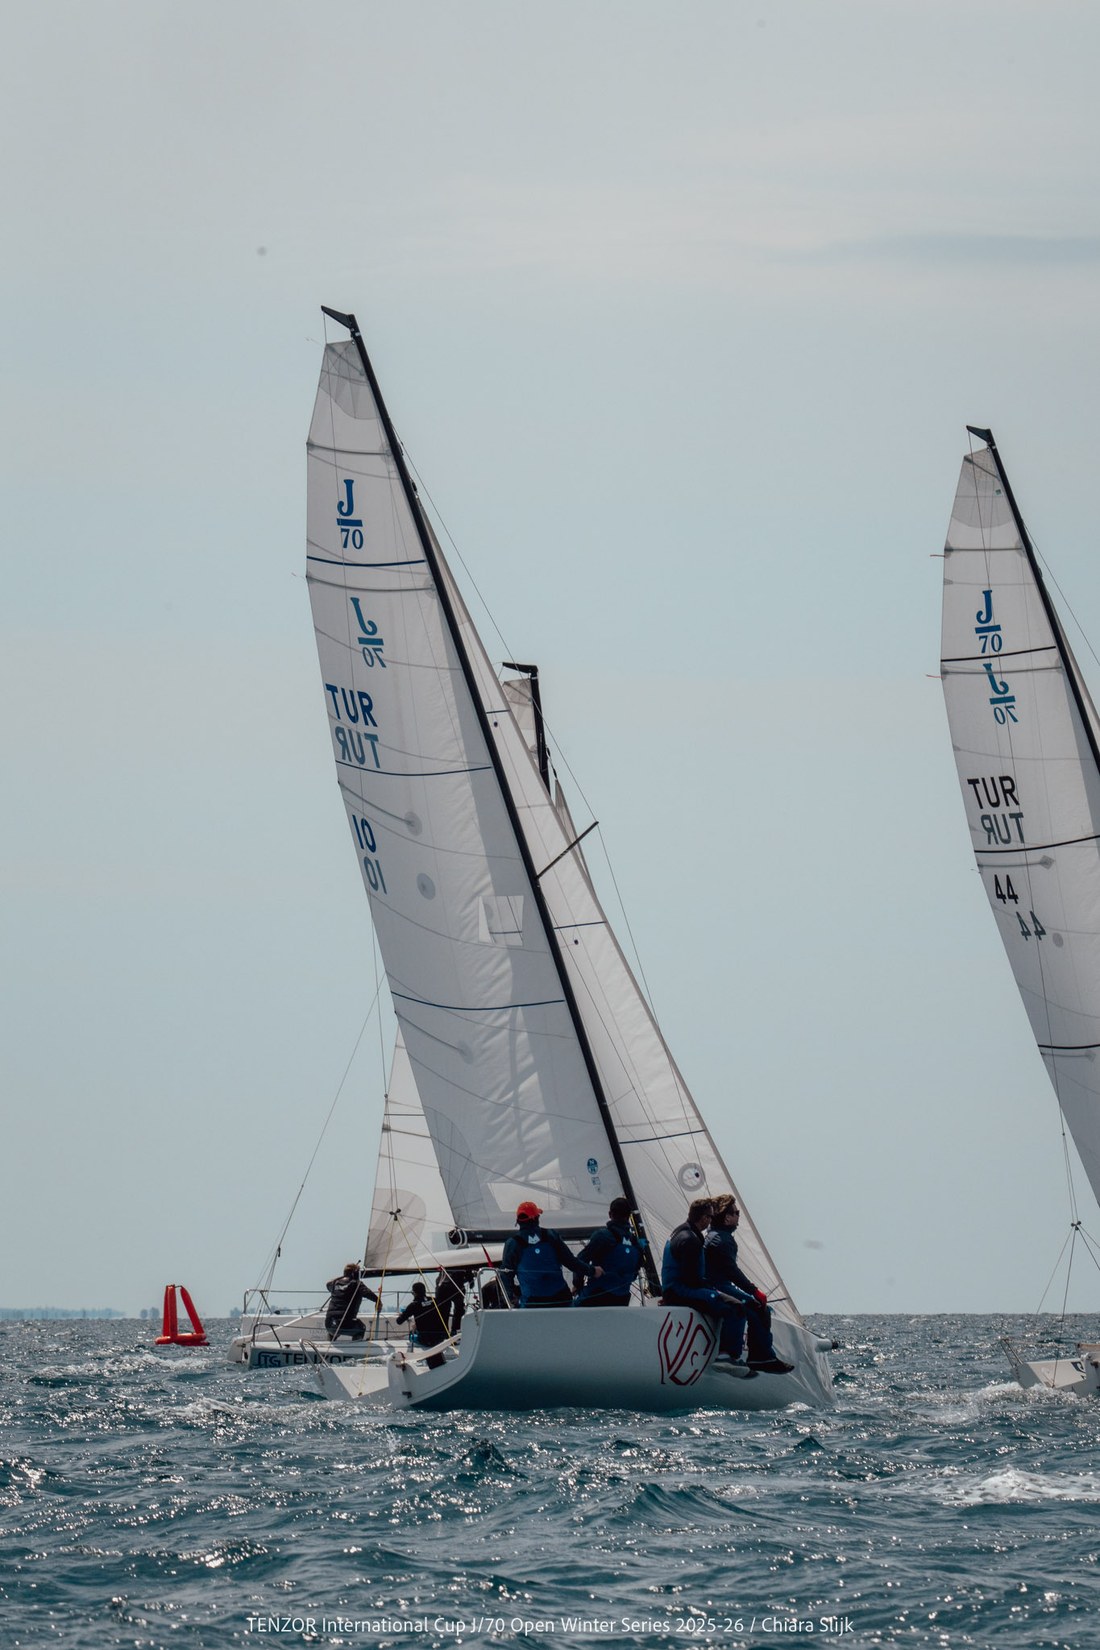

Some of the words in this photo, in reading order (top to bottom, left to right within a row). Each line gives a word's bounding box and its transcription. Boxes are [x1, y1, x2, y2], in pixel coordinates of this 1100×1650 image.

[337, 479, 355, 517] J
[340, 528, 364, 549] 70
[975, 589, 993, 625] J
[978, 633, 1003, 653] 70
[325, 684, 378, 727] TUR
[967, 775, 1020, 810] TUR
[352, 814, 377, 853] 10
[994, 874, 1019, 905] 44
